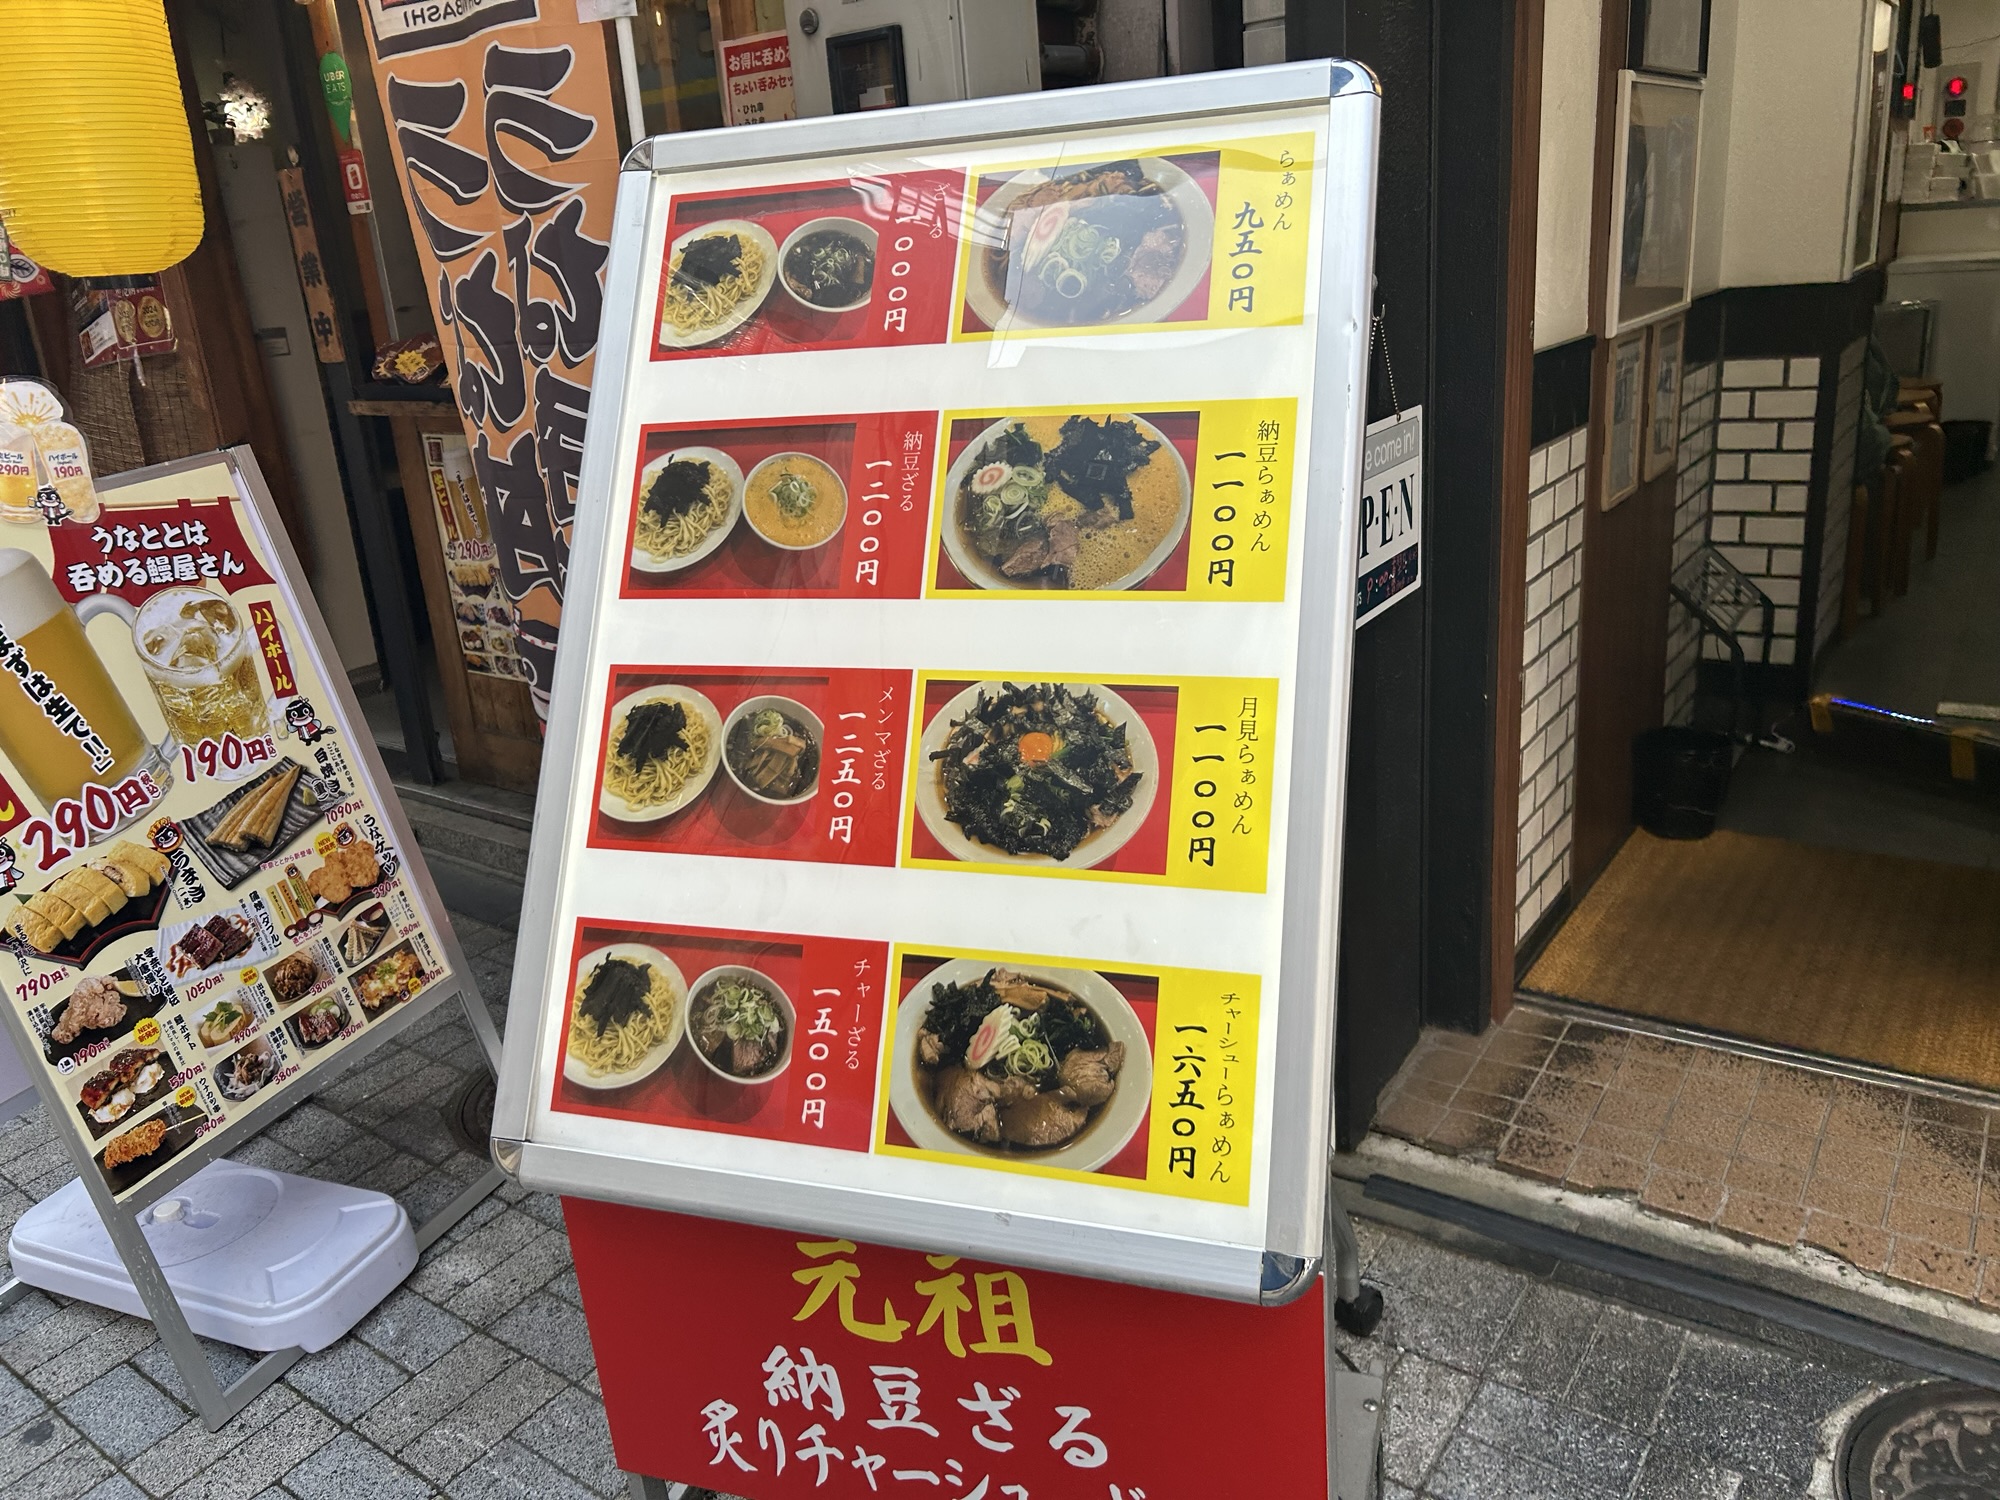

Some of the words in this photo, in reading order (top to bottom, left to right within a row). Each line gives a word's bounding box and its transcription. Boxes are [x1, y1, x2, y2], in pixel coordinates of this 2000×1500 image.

[323, 70, 345, 82] UBER
[728, 45, 790, 72] お得に呑め
[326, 82, 346, 94] EATS
[928, 182, 951, 239] ざる
[1272, 150, 1296, 232] らぁめん
[286, 189, 333, 348] 営業中
[884, 214, 921, 333] 一〇〇〇円
[1228, 201, 1264, 313] 九五〇円
[48, 453, 78, 461] ハイボール
[53, 465, 84, 479] 190円
[900, 430, 923, 512] 納豆ざる
[1374, 438, 1402, 468] come
[1403, 430, 1415, 452] in!
[1250, 420, 1280, 552] 納豆らぁめん
[91, 520, 210, 554] うなととは
[855, 458, 893, 586] 一二〇〇円
[1208, 451, 1247, 588] 一一〇〇円
[67, 549, 246, 593] 呑める鰻屋さん
[254, 607, 292, 692] ハイボール
[182, 734, 268, 783] 190円
[870, 686, 895, 792] メンマざる
[1231, 696, 1259, 835] 月見らぁめん
[828, 711, 868, 845] 一二五〇円
[1188, 722, 1228, 867] 一一〇〇円
[22, 778, 150, 873] 290円
[325, 801, 361, 824] 1090円
[171, 849, 207, 903] うまき
[16, 970, 64, 1001] 790円
[186, 976, 221, 1002] 1050円
[309, 977, 334, 997] 380円
[137, 1022, 153, 1035] NEW
[138, 1026, 160, 1043] 新発売
[232, 1025, 259, 1045] 490円
[339, 1022, 363, 1042] 380円
[845, 957, 871, 1071] チャーざる
[75, 1042, 107, 1067] 190円
[169, 1064, 203, 1089] 590円
[273, 1064, 299, 1086] 380円
[801, 986, 841, 1130] 一五〇〇円
[1168, 1023, 1208, 1180] 一六五〇円
[1208, 993, 1240, 1184] チャーシューらぁめん
[195, 1116, 225, 1139] 340円
[791, 1238, 1053, 1366] 元祖
[762, 1345, 1108, 1468] 納豆ざる
